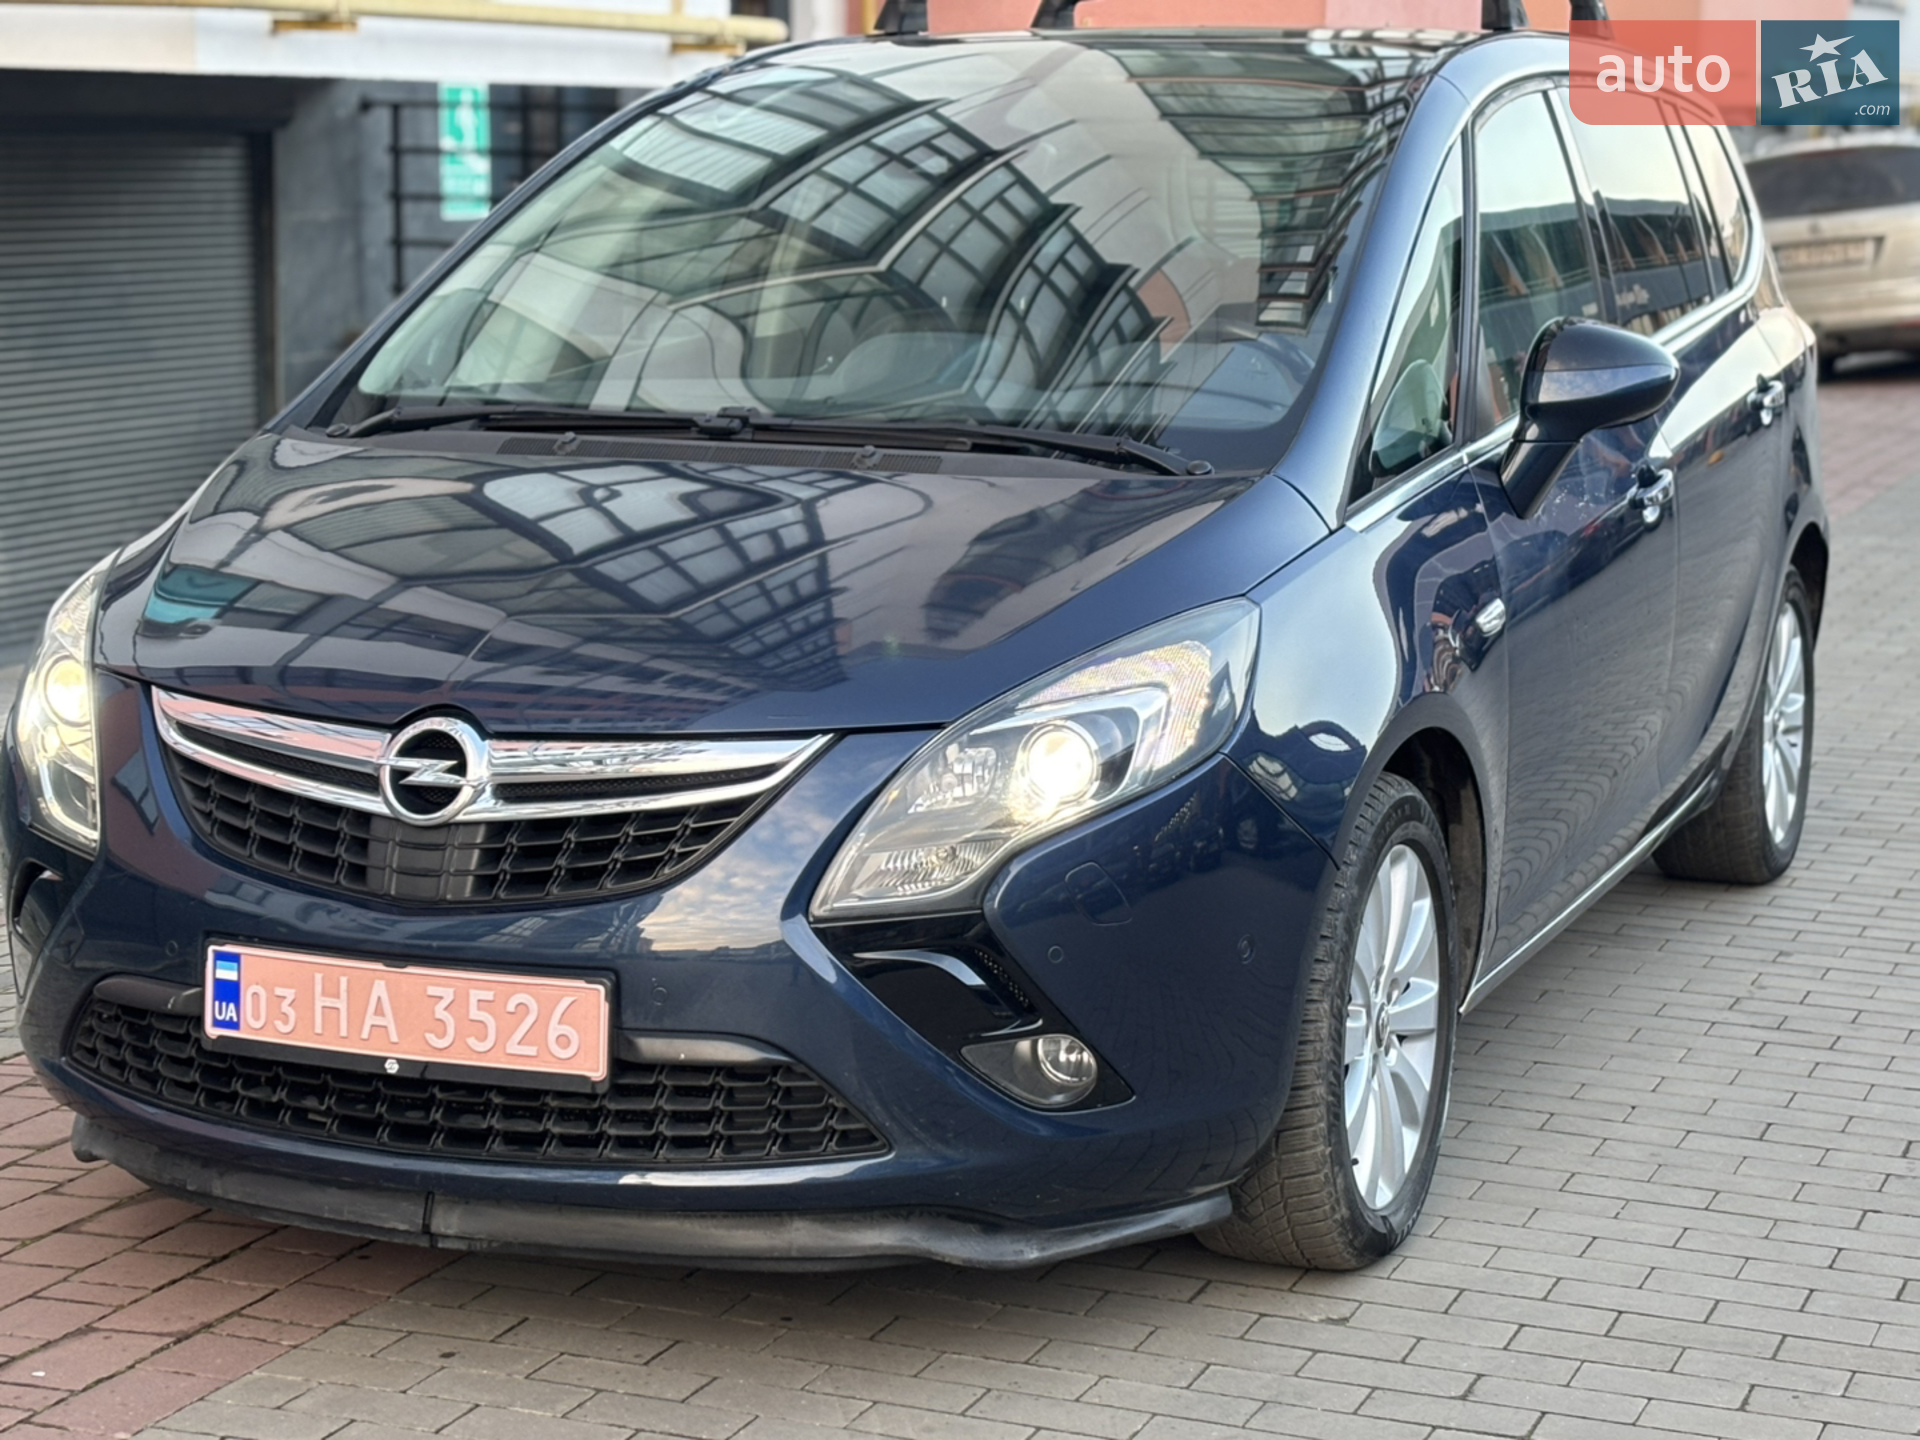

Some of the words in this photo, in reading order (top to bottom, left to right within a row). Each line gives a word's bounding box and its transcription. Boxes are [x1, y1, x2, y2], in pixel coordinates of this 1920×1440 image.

[214, 1001, 238, 1022] UA
[244, 984, 297, 1034] 03
[313, 973, 400, 1043] HA
[424, 985, 581, 1060] 3526
